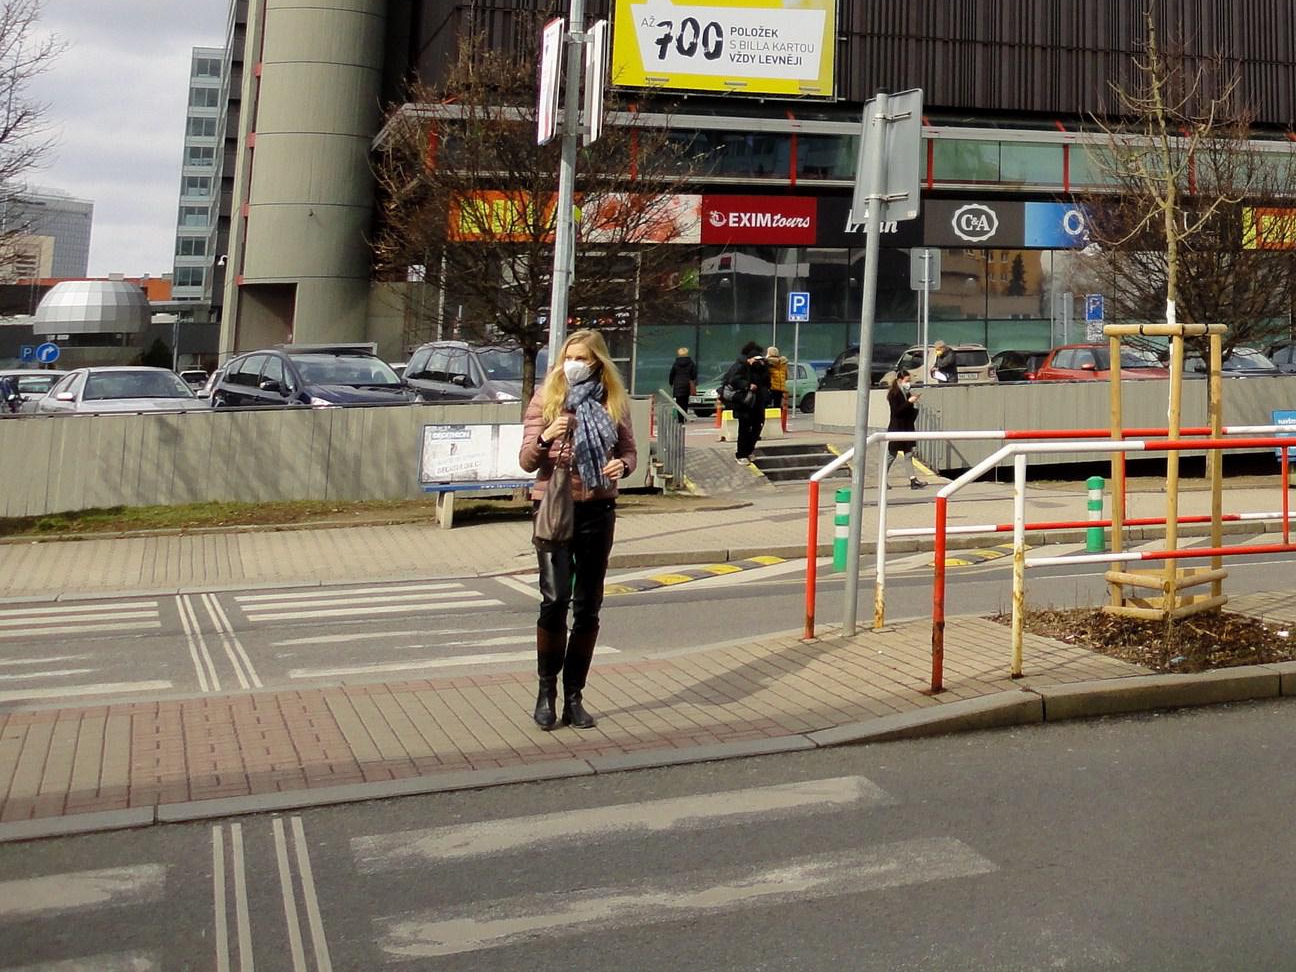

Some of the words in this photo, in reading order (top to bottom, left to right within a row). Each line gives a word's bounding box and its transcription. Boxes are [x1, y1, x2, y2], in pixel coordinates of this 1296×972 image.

[641, 15, 655, 28] AŽ
[655, 17, 724, 60] 700
[730, 26, 779, 38] POLOŽEK
[729, 40, 737, 50] S
[739, 40, 770, 51] BILLA
[772, 42, 815, 53] KARTOU
[729, 52, 756, 64] VŽDY
[758, 53, 802, 66] LEVNĚJI
[960, 214, 990, 231] C&A
[793, 295, 805, 313] P
[23, 347, 32, 358] P
